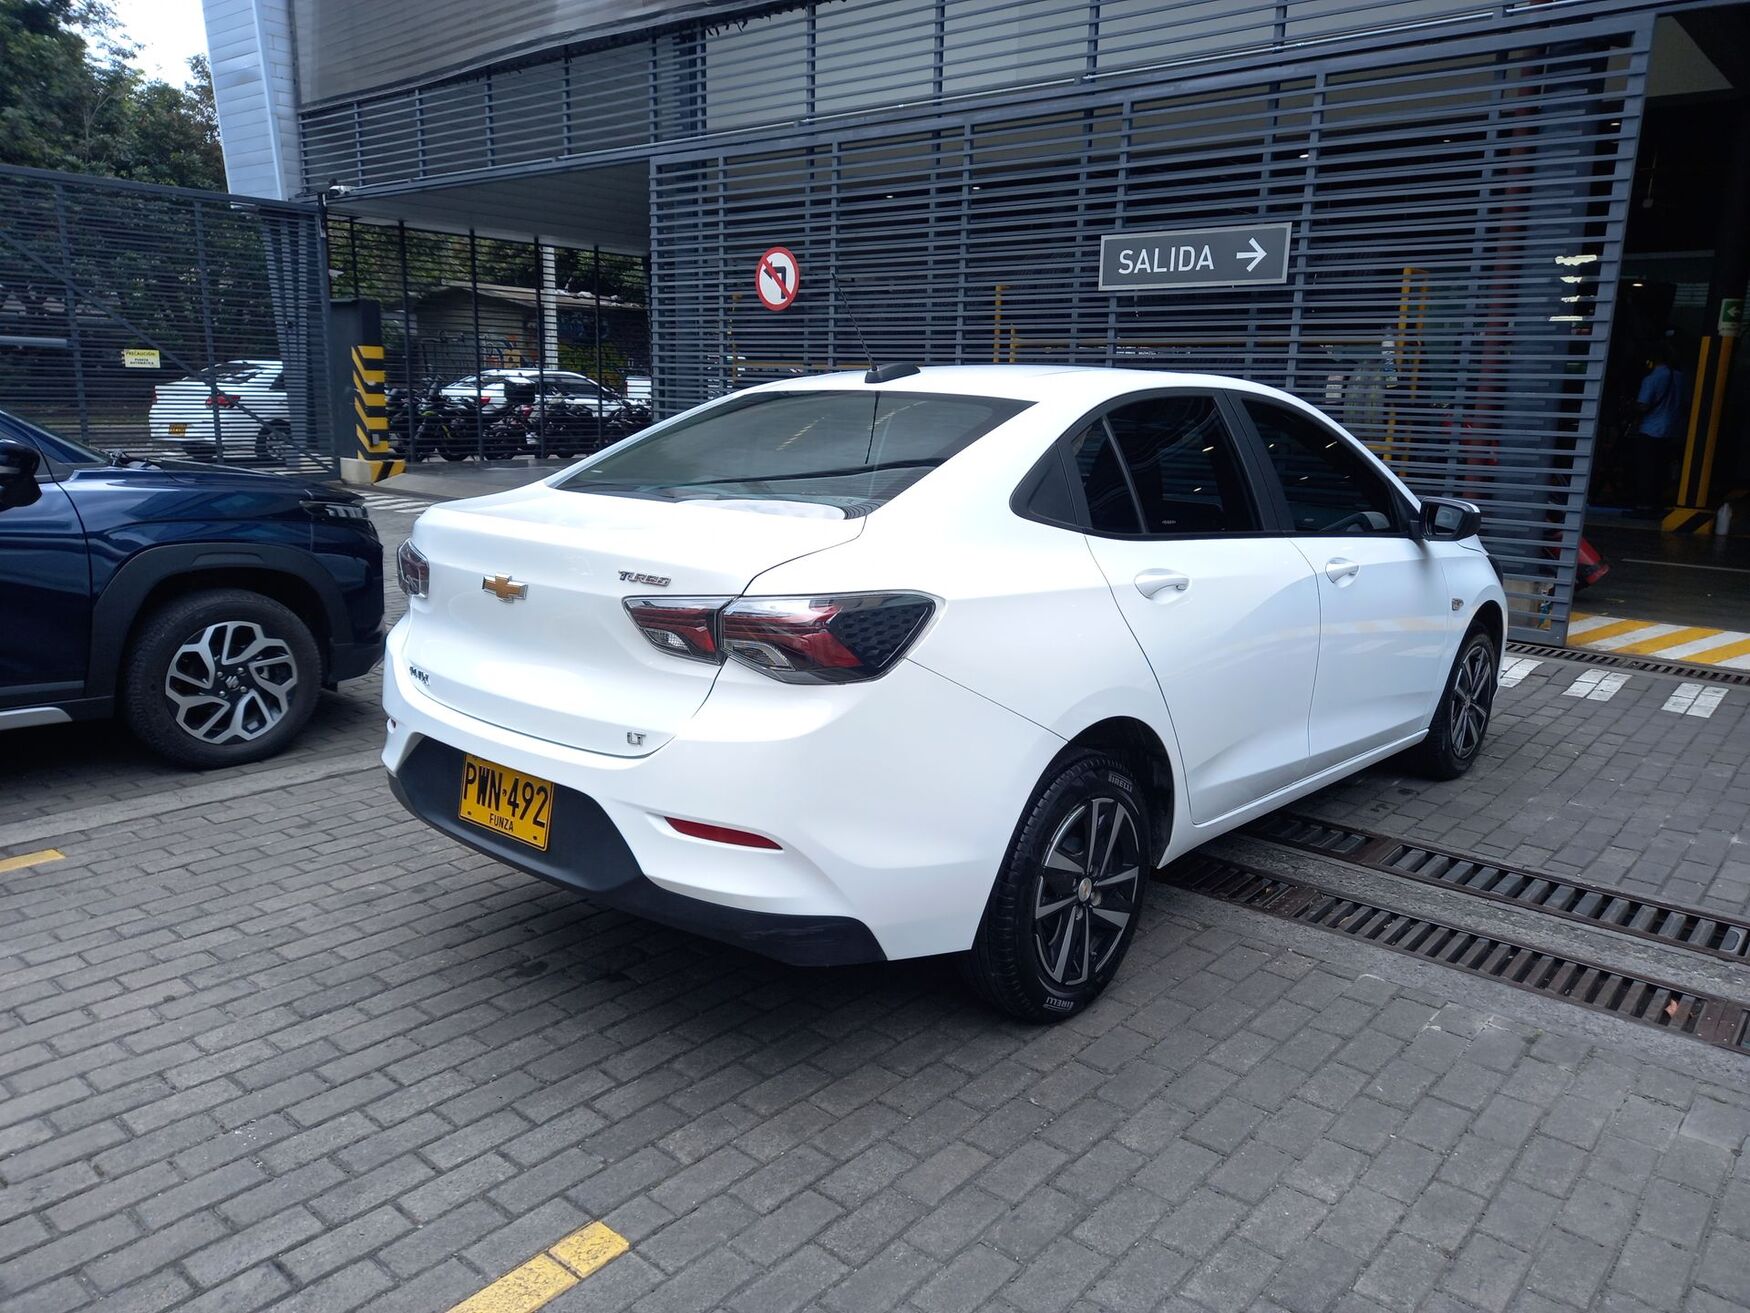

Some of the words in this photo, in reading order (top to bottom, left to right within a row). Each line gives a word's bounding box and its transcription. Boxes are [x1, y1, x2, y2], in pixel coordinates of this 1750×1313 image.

[1118, 244, 1215, 275] SALIDA
[618, 570, 671, 587] TURBO
[627, 731, 646, 746] LT
[489, 813, 513, 832] FUNZA
